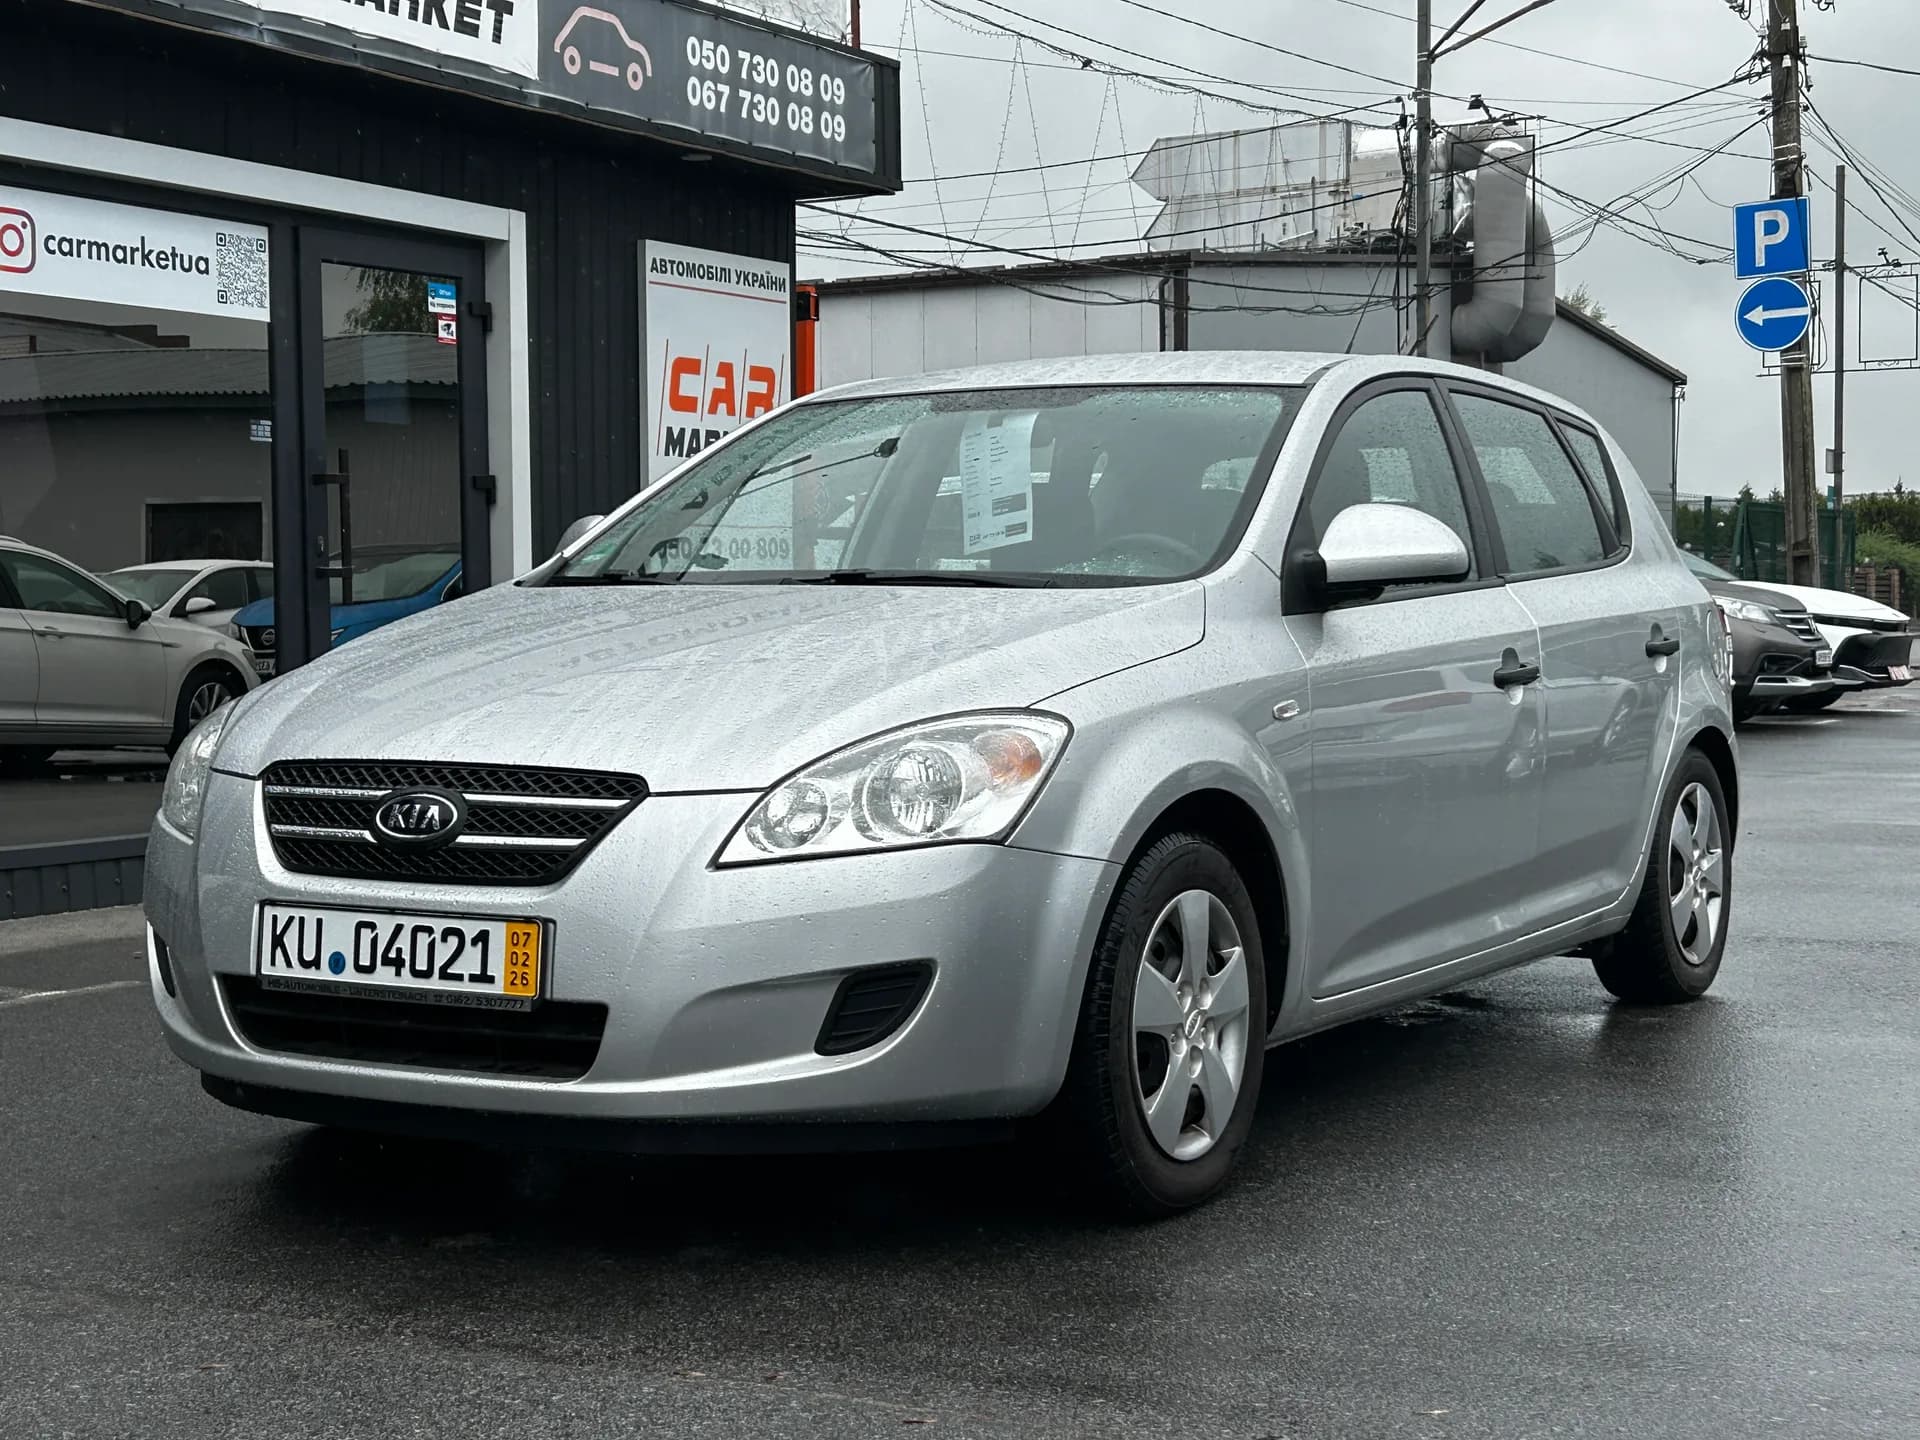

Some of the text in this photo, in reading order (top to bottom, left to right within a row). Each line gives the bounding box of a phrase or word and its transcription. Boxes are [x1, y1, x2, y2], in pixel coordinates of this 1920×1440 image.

[686, 36, 845, 104] 050 730 08 09
[687, 76, 846, 142] 067 730 08 09
[43, 233, 210, 275] carmarketua
[1754, 209, 1790, 268] P
[650, 257, 787, 293] АВТОМОБІЛІ УКРАЇНИ
[669, 356, 776, 418] CAR
[388, 803, 441, 830] KIA
[269, 913, 496, 985] KU 04021
[510, 931, 532, 947] 07
[510, 951, 531, 968] 02
[509, 970, 530, 987] 26
